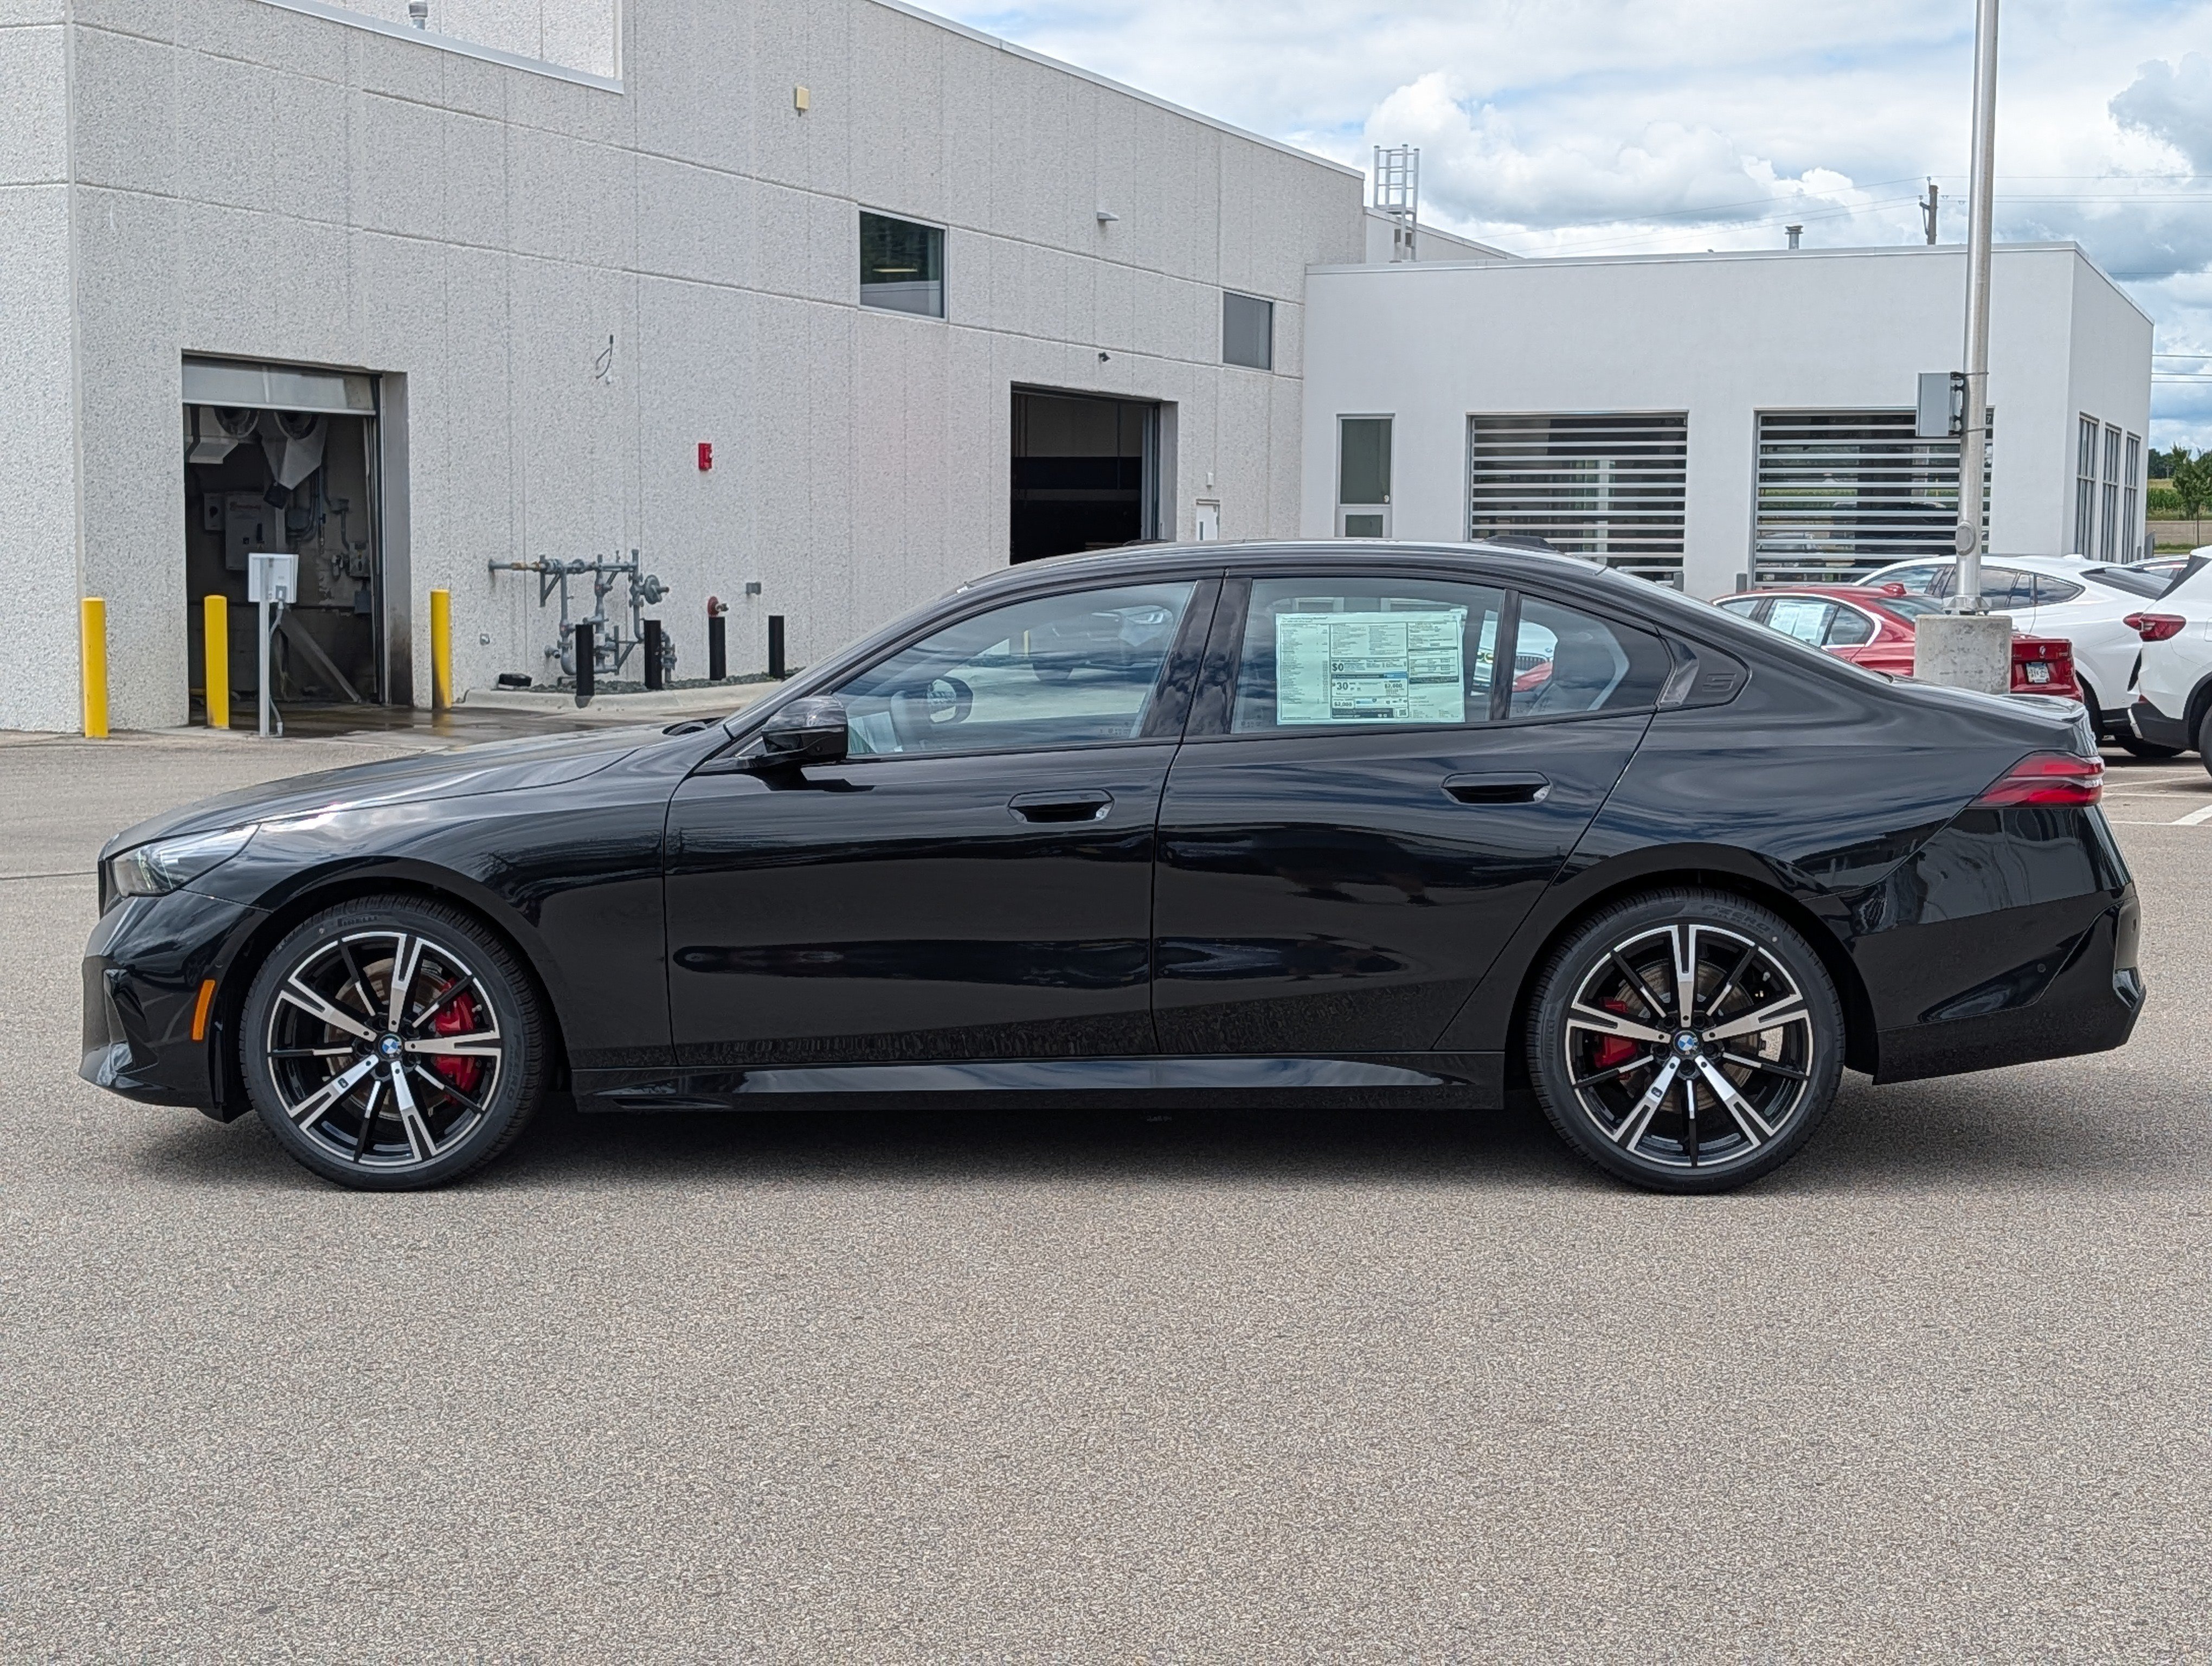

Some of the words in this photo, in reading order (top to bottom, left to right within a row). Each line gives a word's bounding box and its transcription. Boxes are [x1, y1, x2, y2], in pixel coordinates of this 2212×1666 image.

[1332, 663, 1344, 671] $0
[1336, 682, 1349, 690] 30
[1702, 673, 1737, 692] 5
